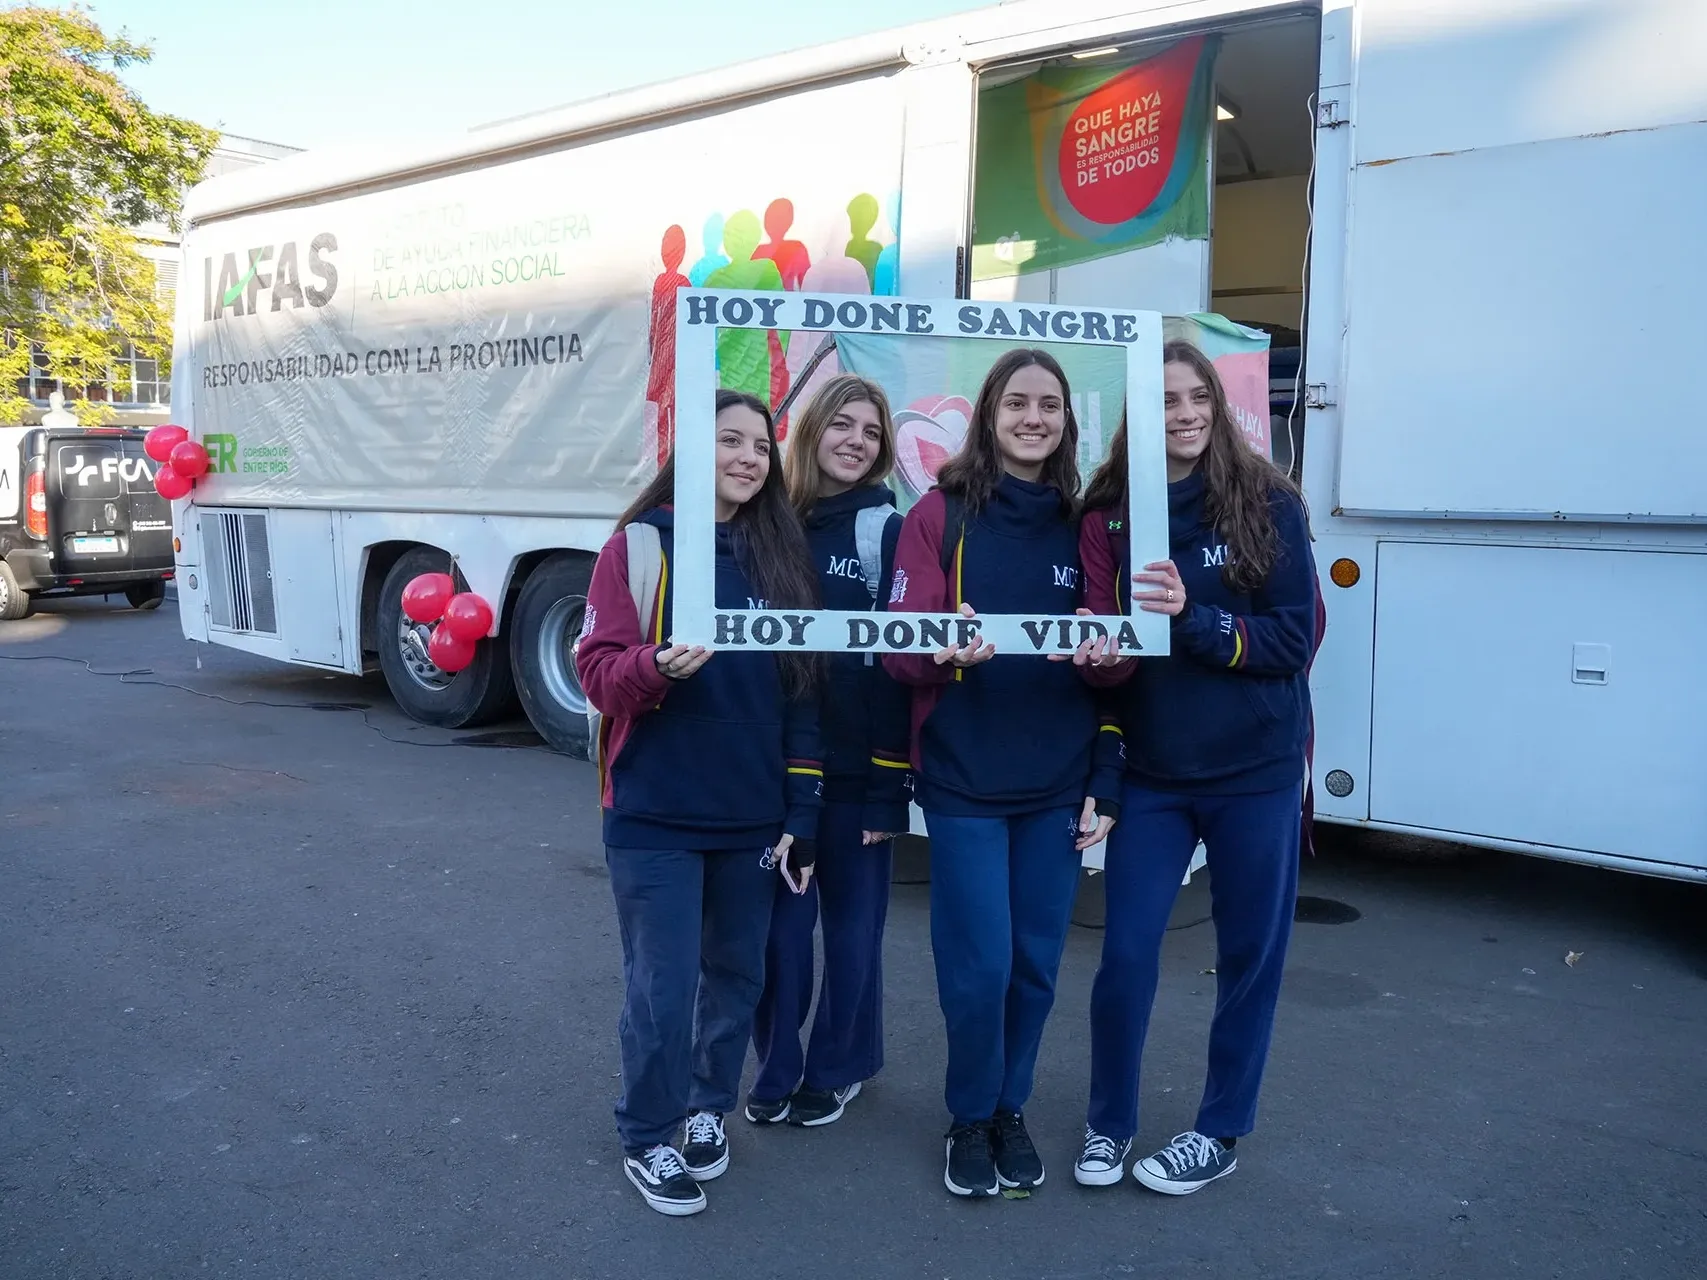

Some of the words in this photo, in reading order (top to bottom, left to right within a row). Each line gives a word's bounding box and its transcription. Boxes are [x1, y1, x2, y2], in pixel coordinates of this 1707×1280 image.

[1075, 108, 1112, 134] QUE
[1120, 90, 1161, 120] HAYA
[1076, 111, 1160, 157] SANGRE
[1077, 160, 1087, 169] ES
[1089, 135, 1159, 166] RESPONSABILIDAD
[1078, 167, 1098, 187] DE
[1104, 147, 1159, 178] TODOS
[203, 232, 339, 322] IAFAS
[371, 279, 383, 301] A
[387, 275, 409, 299] LA
[491, 252, 566, 285] SOCIAL
[686, 296, 785, 327] HOY
[801, 299, 935, 333] DONE
[958, 306, 1140, 344] SANGRE
[203, 352, 359, 389] RESPONSABILIDAD
[365, 348, 409, 376] CON
[417, 345, 442, 374] LA
[450, 333, 584, 371] PROVINCIA
[101, 457, 155, 482] FCA
[203, 433, 238, 473] ER
[243, 461, 268, 473] ENTRE
[714, 614, 815, 645] HOY
[847, 618, 983, 650] DONE
[1021, 620, 1143, 651] VIDA
